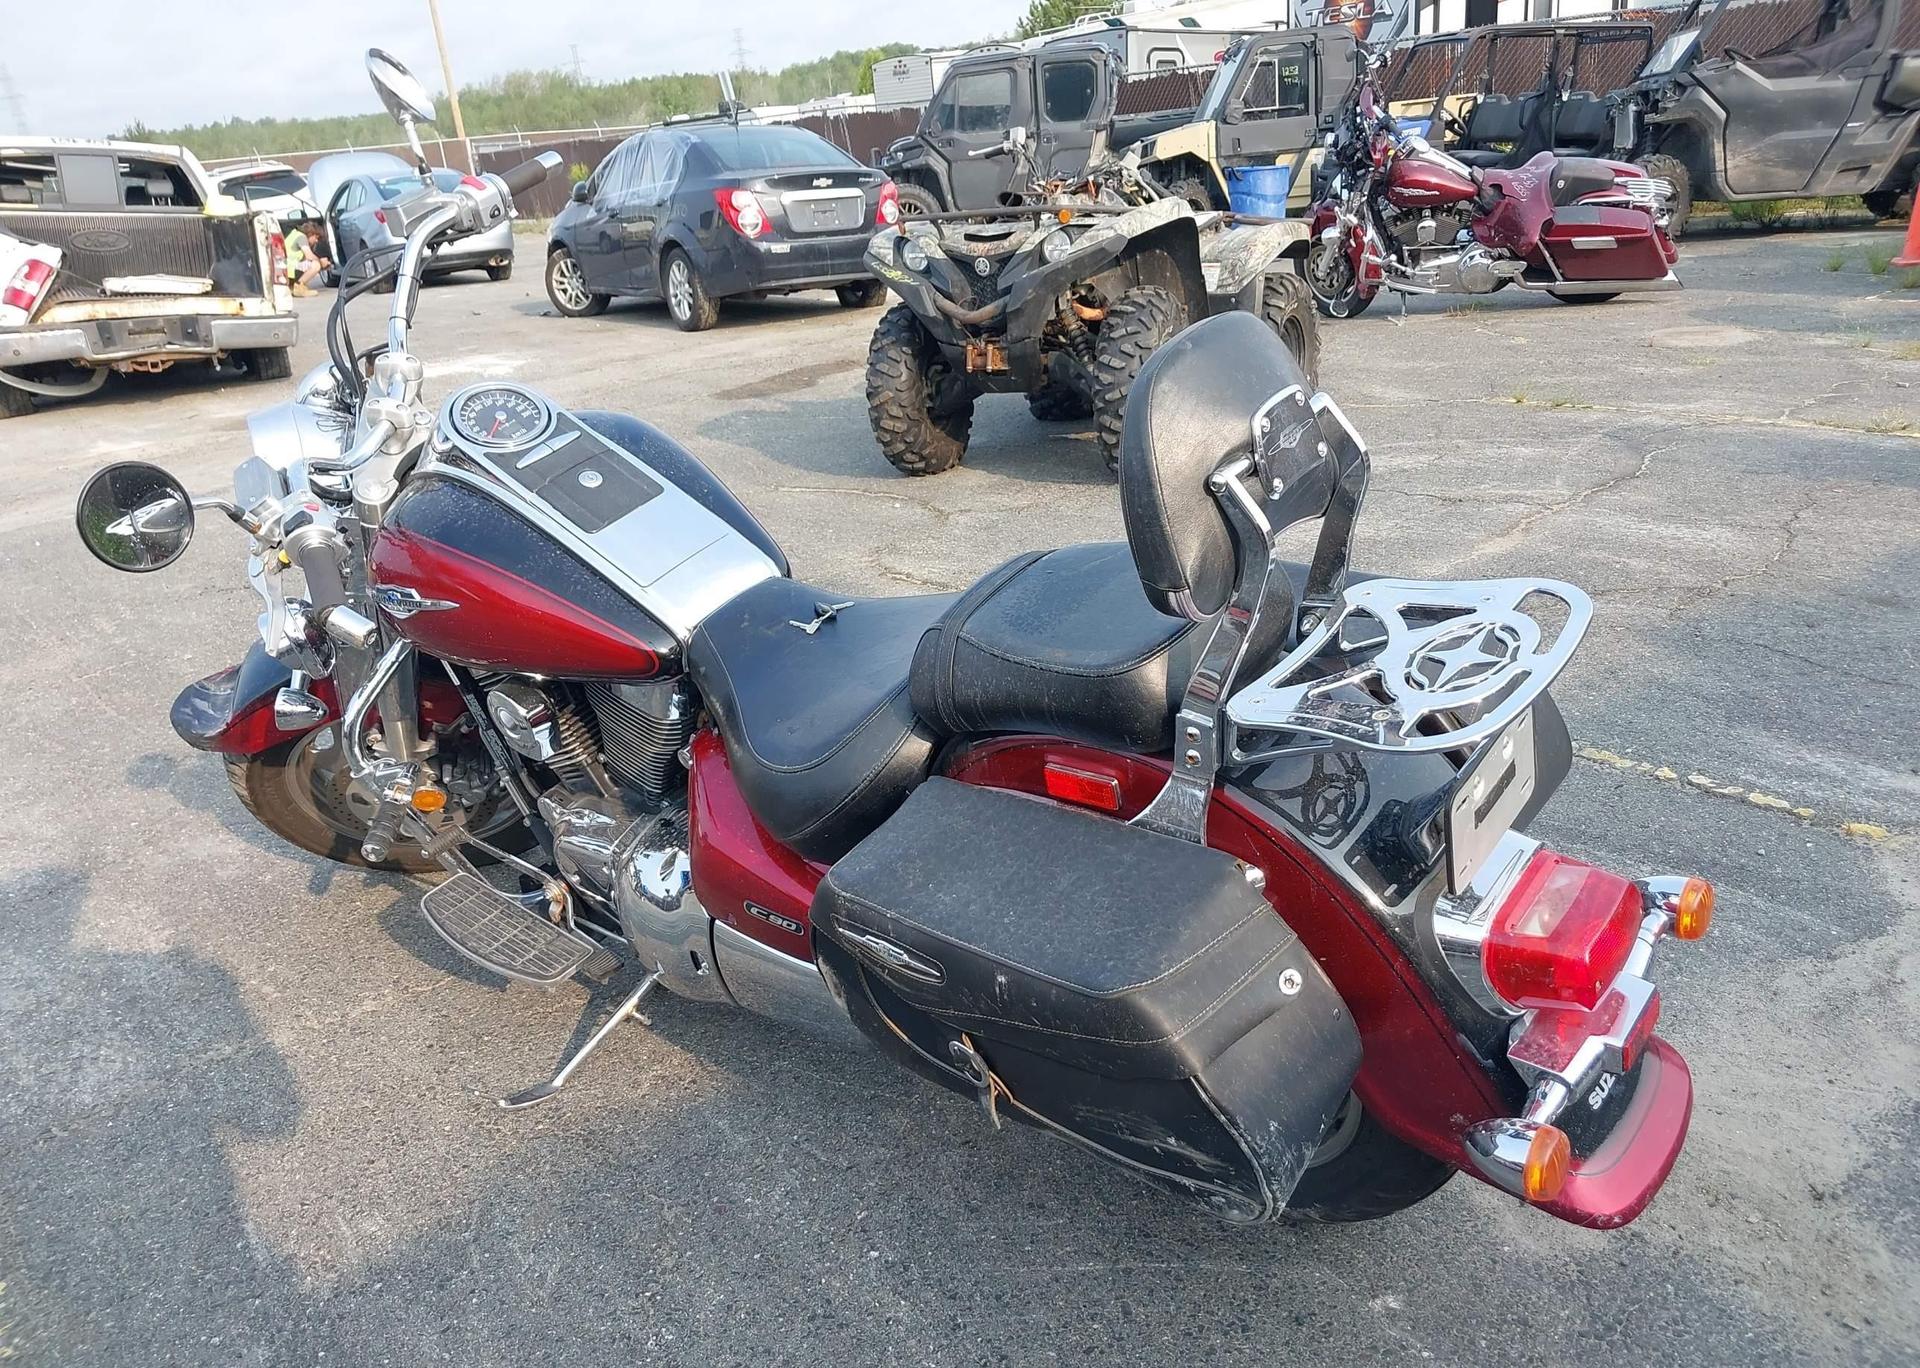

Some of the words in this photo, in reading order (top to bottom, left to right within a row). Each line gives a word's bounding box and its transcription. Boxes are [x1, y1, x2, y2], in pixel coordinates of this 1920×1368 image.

[1305, 0, 1394, 27] TESLA
[511, 426, 527, 439] km/h
[750, 906, 797, 931] C90
